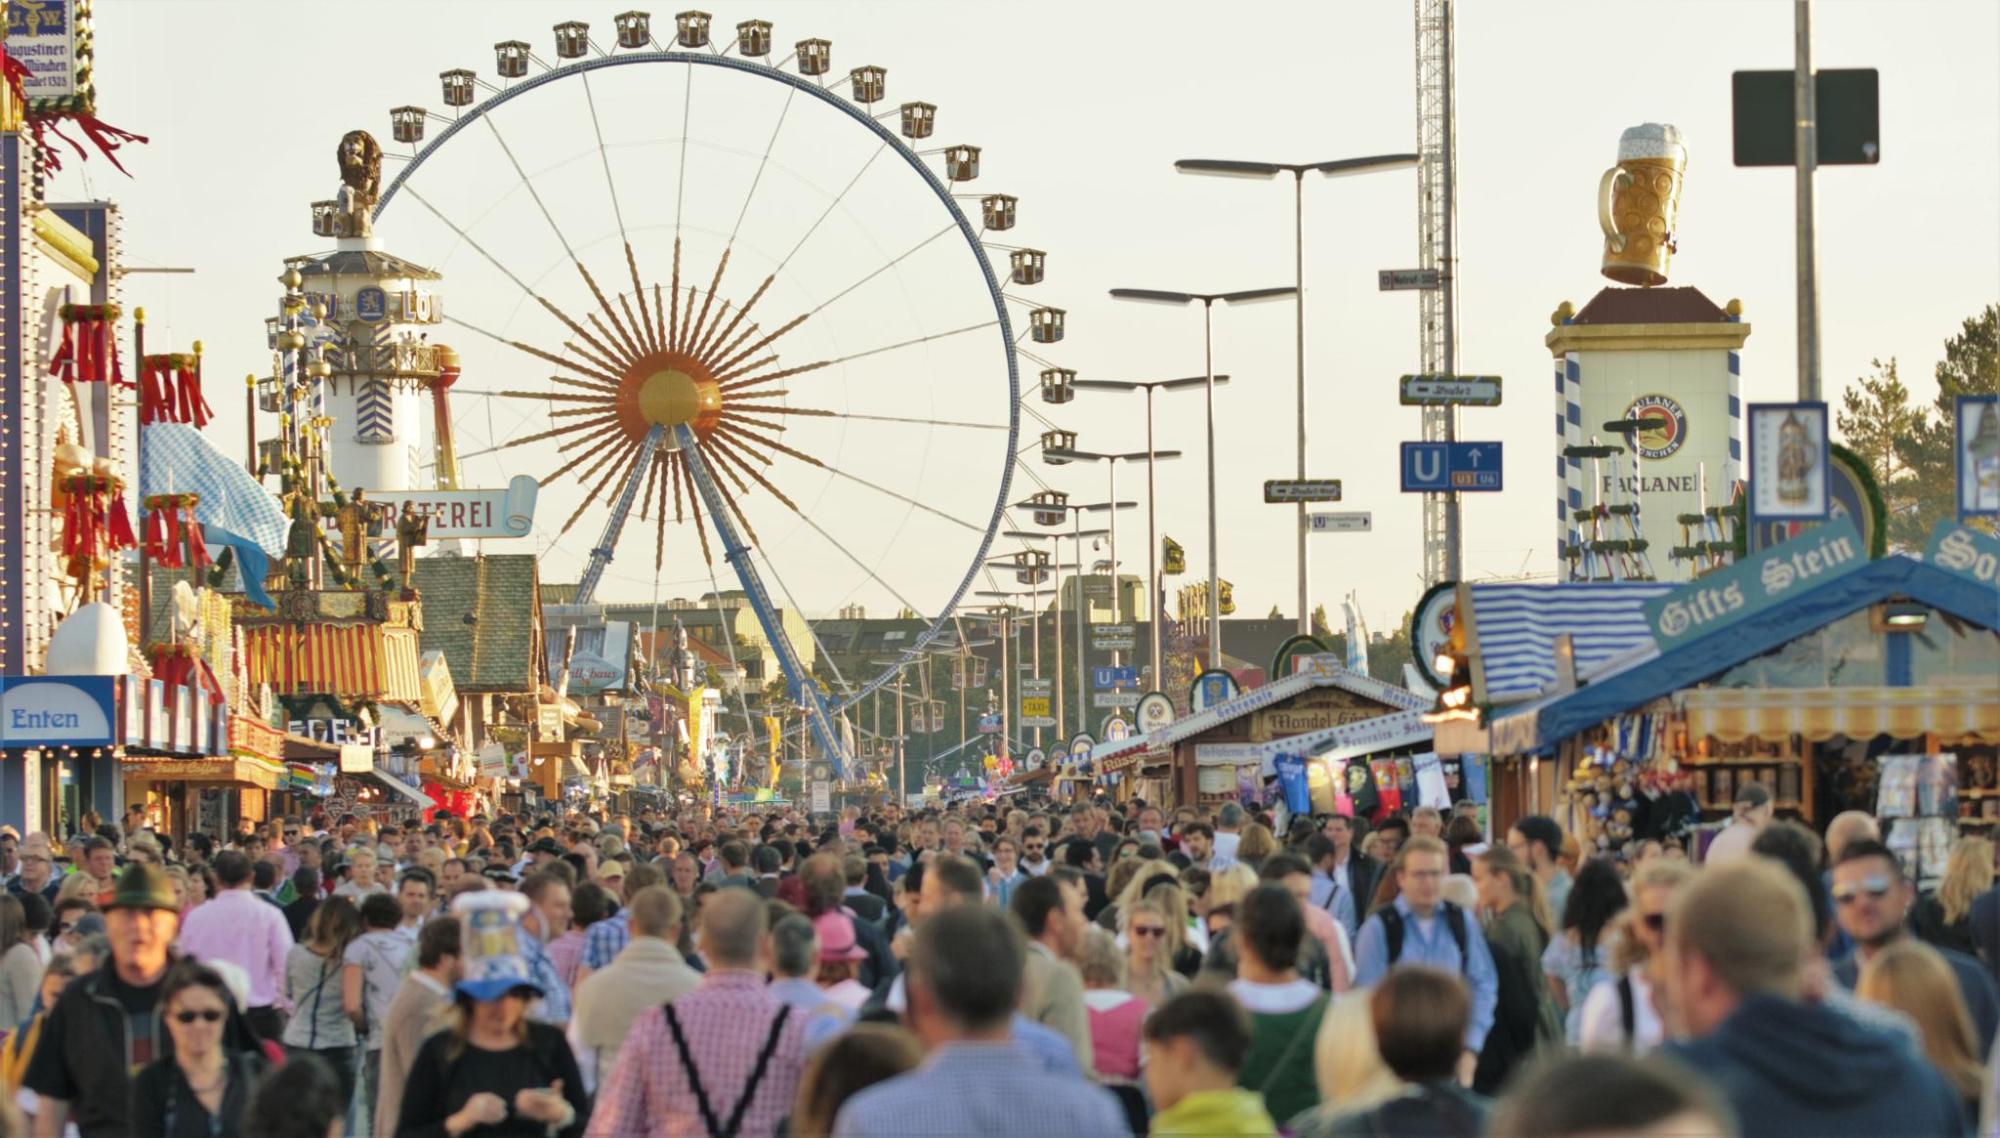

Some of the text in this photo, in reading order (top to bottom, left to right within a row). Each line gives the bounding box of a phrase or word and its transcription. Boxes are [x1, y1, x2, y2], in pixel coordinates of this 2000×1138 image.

[1414, 450, 1440, 482] U
[1479, 474, 1496, 486] U6
[1658, 533, 1855, 637] Gifts Stein
[1099, 671, 1111, 684] U
[1028, 702, 1045, 712] TAXI
[11, 708, 79, 729] Enten
